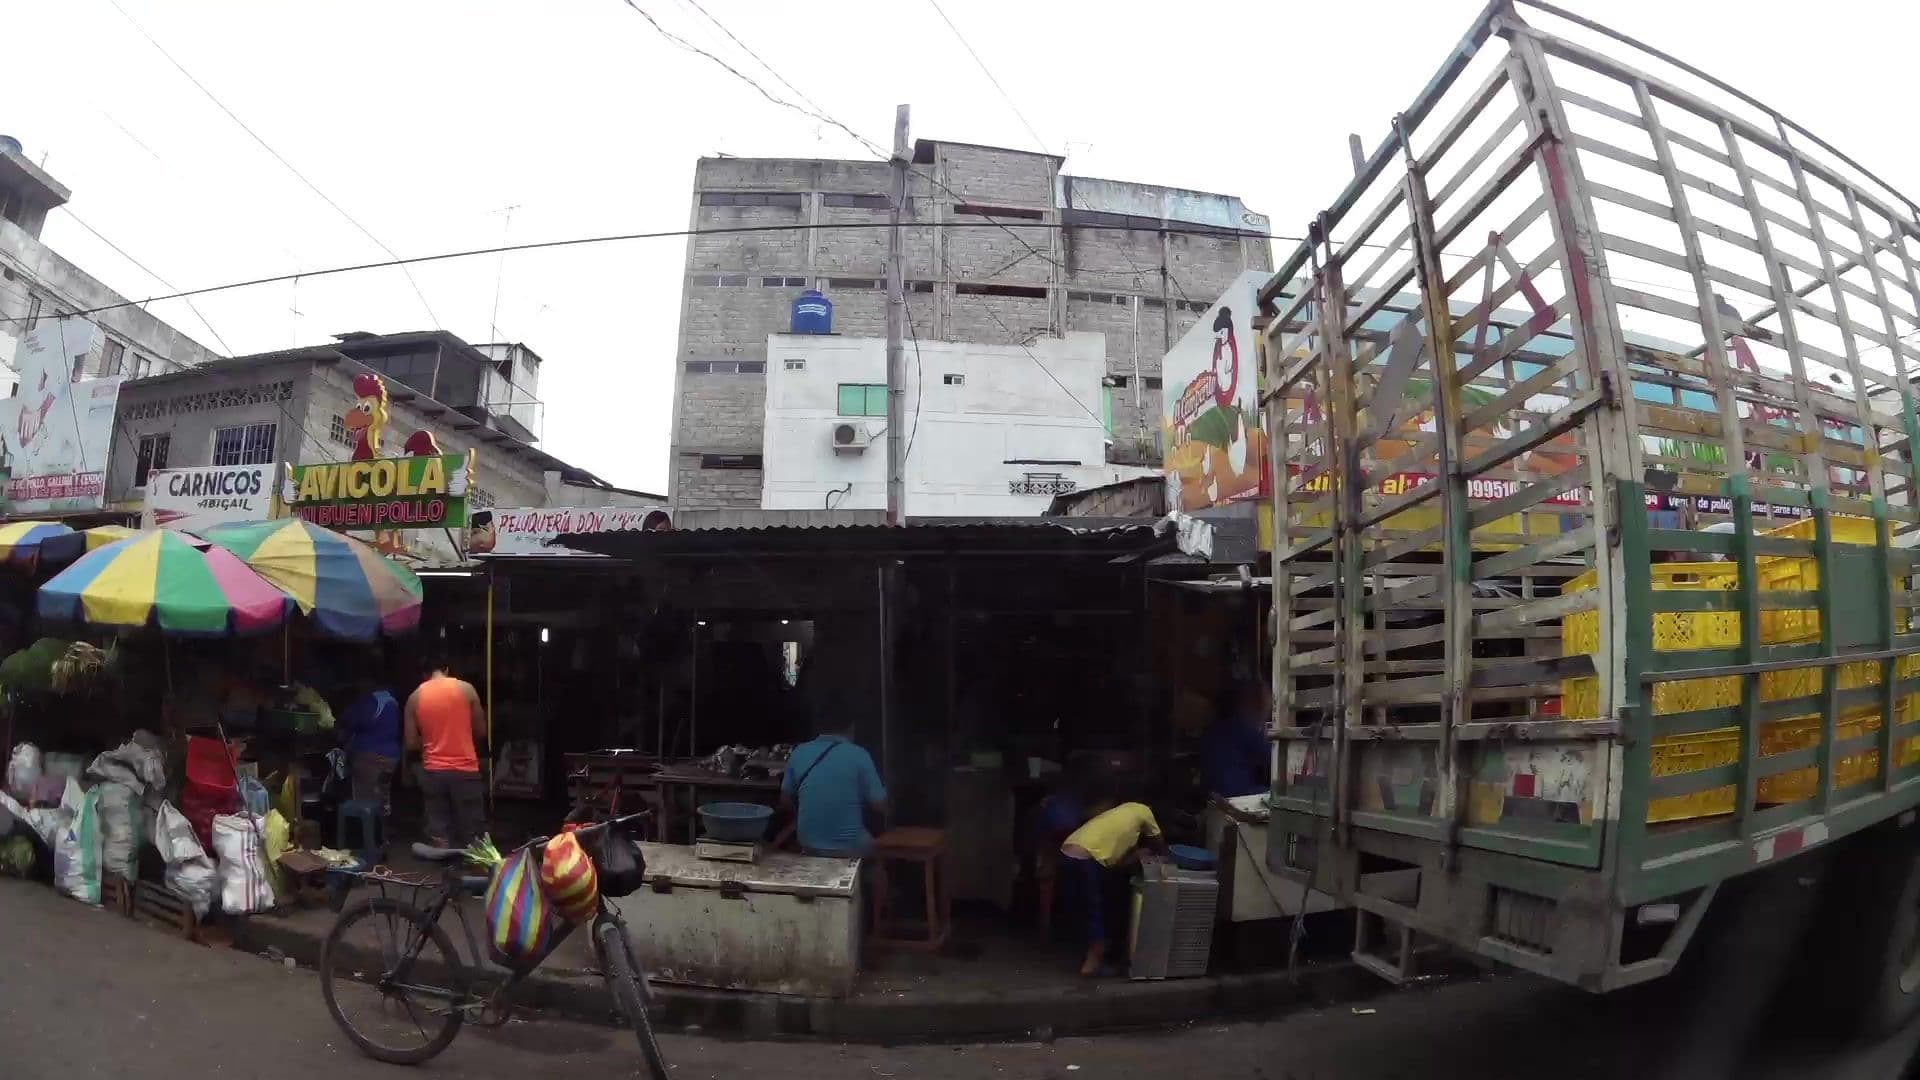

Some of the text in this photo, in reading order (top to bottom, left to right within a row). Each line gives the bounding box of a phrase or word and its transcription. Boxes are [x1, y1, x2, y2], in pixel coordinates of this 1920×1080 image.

[169, 470, 262, 496] CARNICOS
[197, 498, 252, 511] ABIGAIL
[319, 503, 372, 525] BUEN
[375, 500, 444, 524] POLLO
